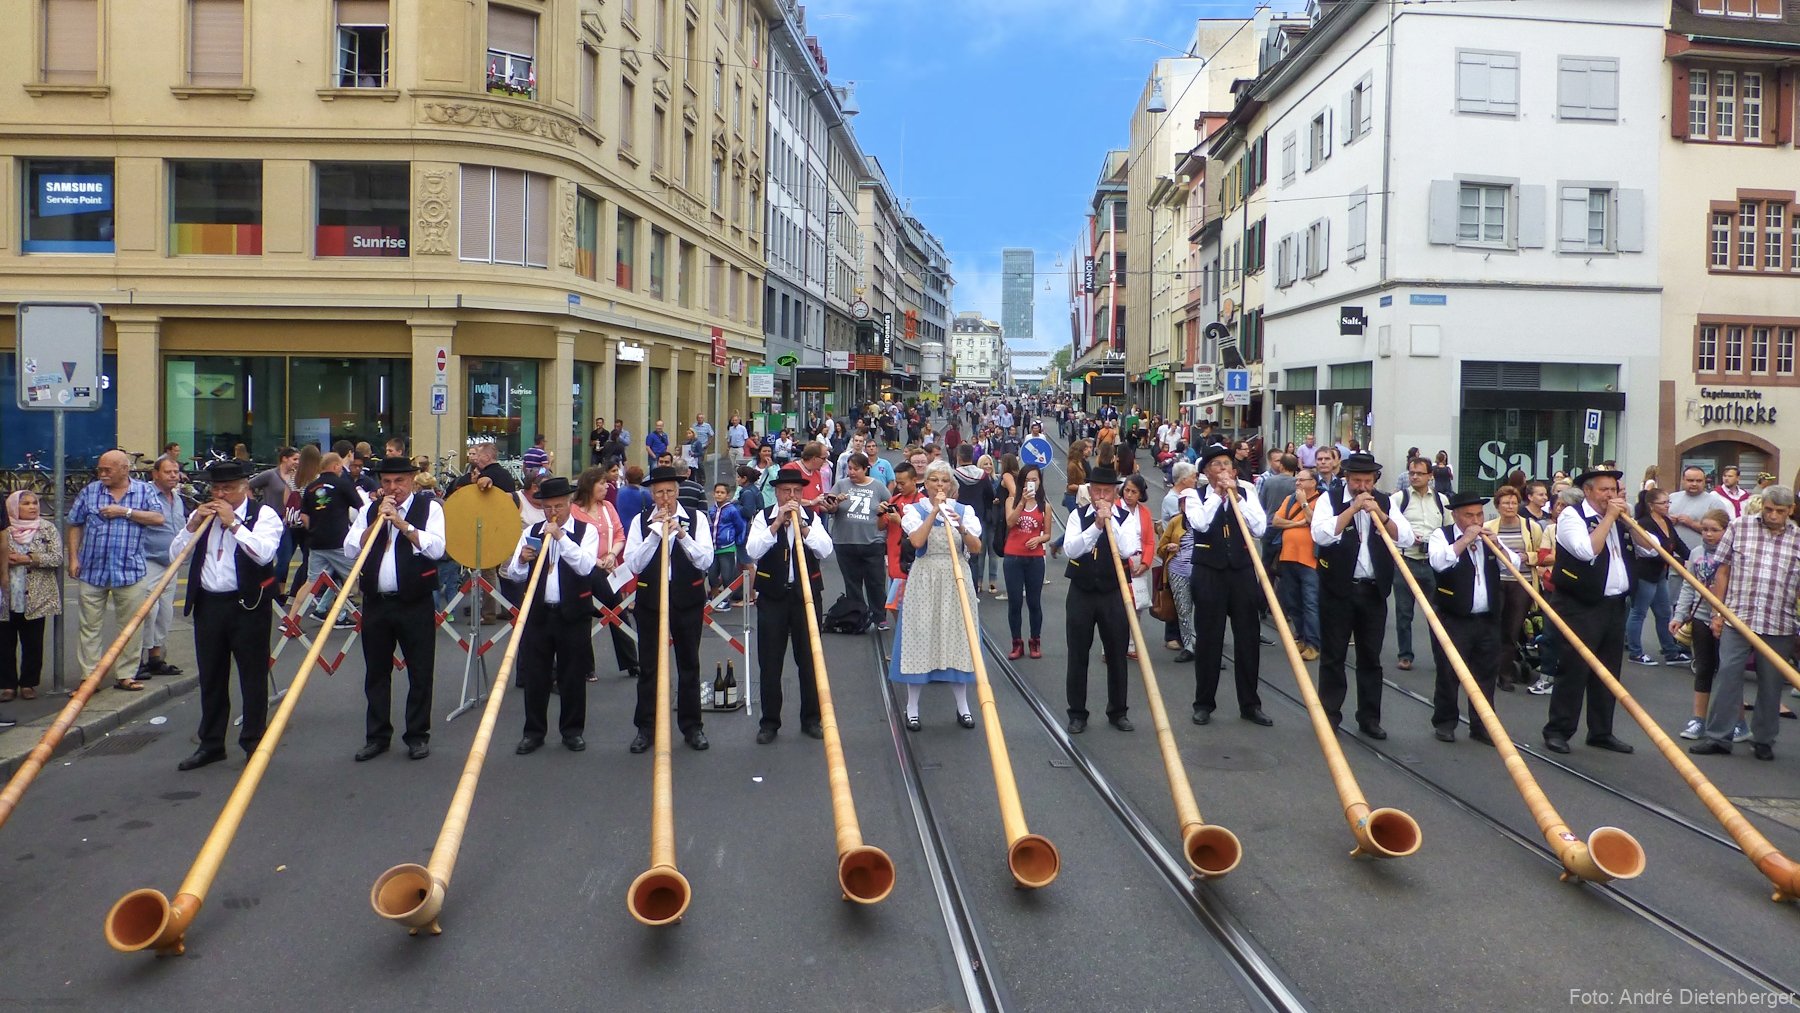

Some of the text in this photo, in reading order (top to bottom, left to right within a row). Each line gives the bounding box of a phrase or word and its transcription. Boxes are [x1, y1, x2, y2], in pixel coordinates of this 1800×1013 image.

[46, 182, 103, 192] SAMSUNG
[46, 195, 102, 204] Service Point
[353, 236, 406, 248] Sunrise
[1342, 317, 1361, 325] Salt.
[1590, 414, 1597, 428] P
[1478, 440, 1583, 480] Salt.
[848, 496, 870, 514] 71
